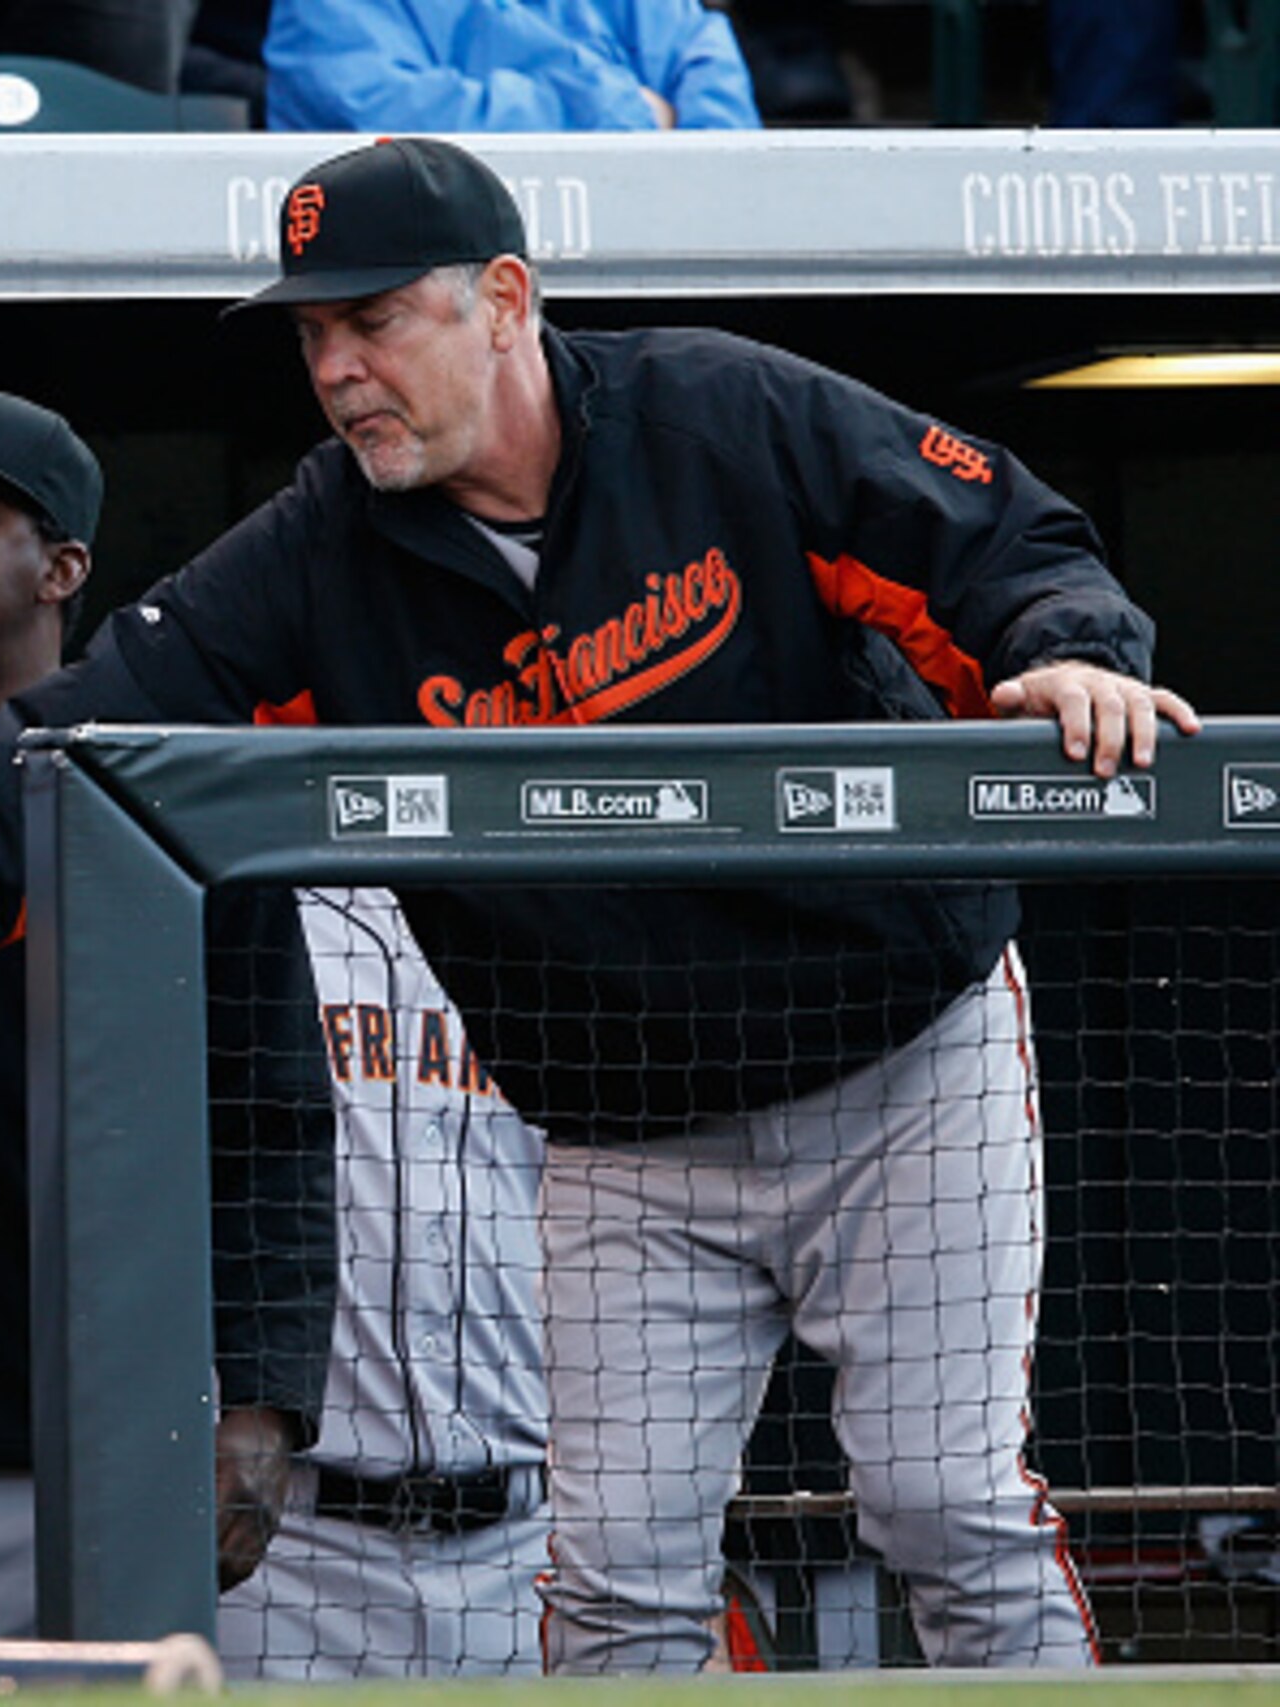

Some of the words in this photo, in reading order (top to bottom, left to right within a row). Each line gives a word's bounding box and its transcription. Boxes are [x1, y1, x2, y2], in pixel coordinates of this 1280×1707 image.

[962, 172, 1136, 256] COORS
[529, 788, 652, 817] MLB.com
[978, 783, 1101, 812] MLB.com
